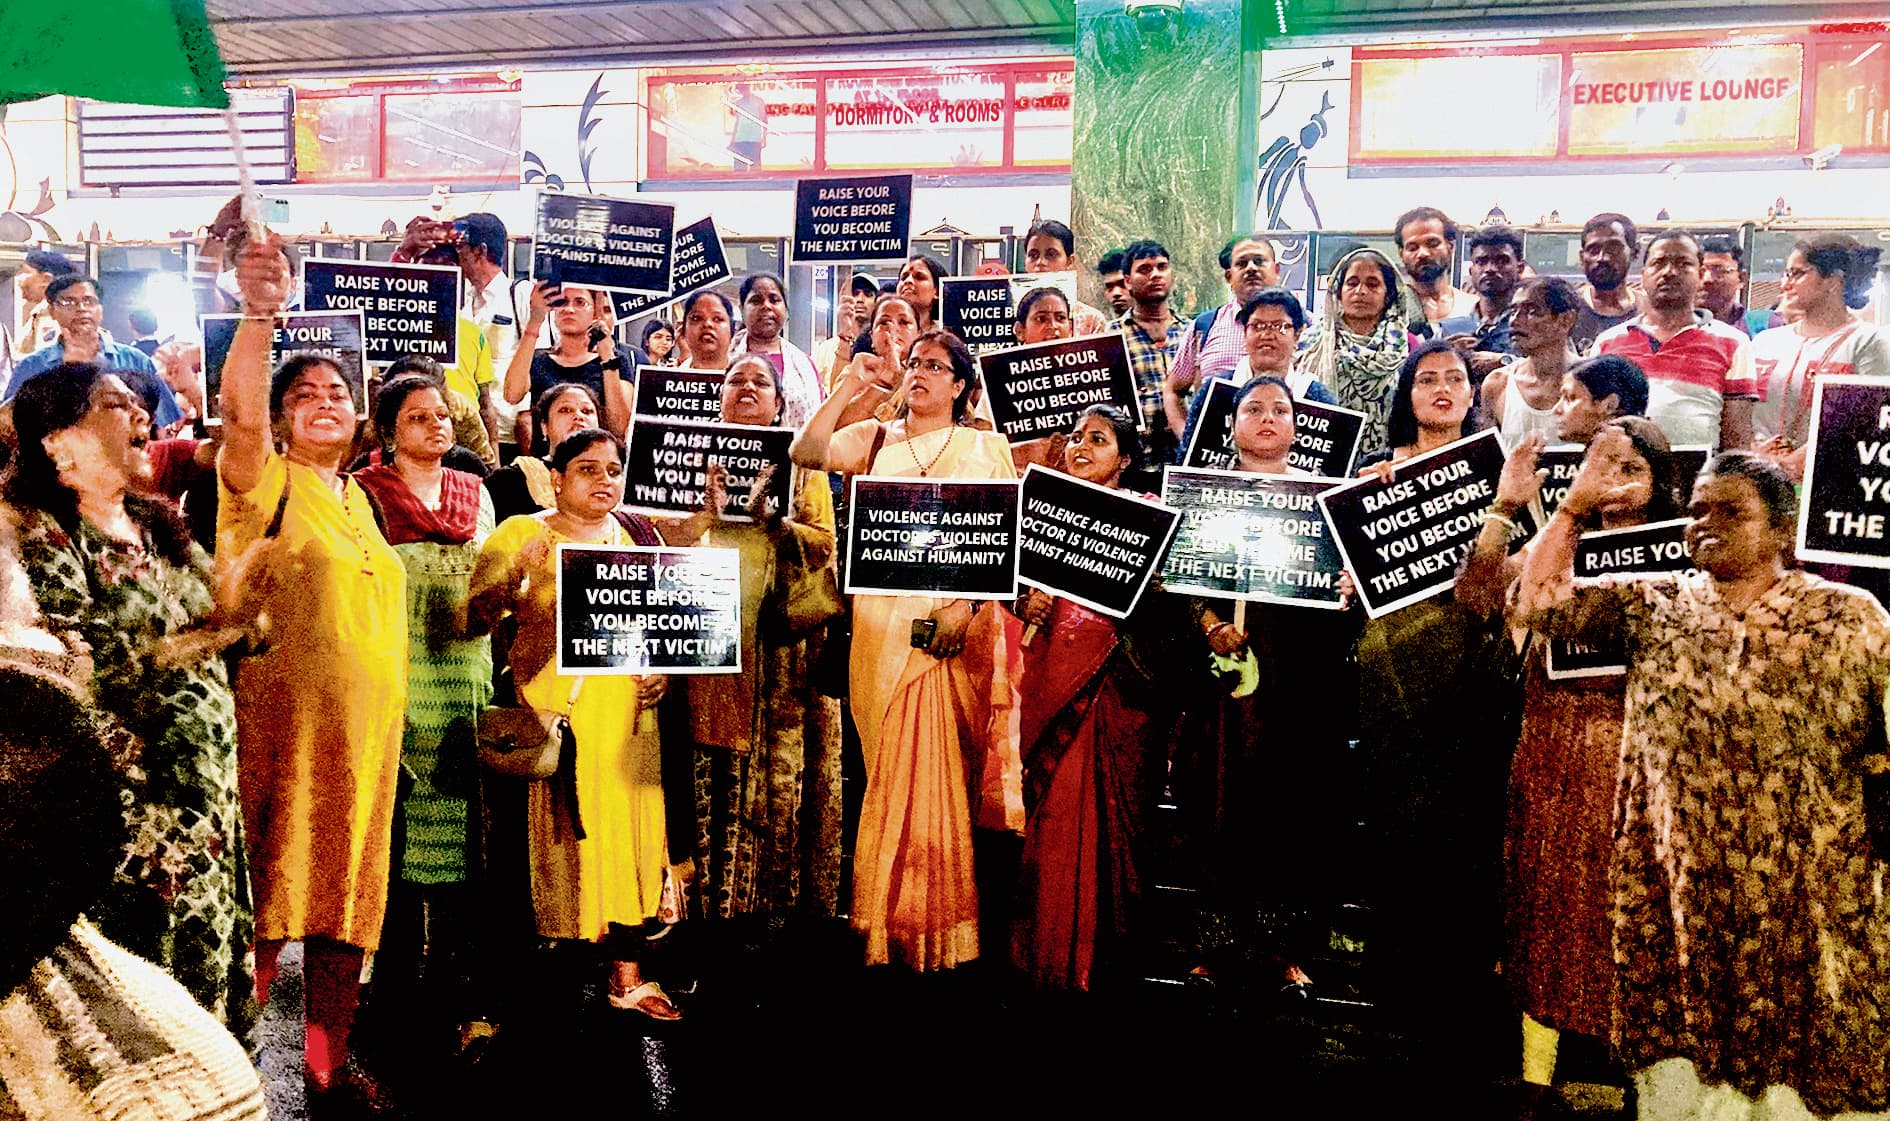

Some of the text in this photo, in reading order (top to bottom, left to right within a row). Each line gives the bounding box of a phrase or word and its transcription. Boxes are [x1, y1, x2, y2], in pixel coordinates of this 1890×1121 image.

[1573, 77, 1790, 105] EXECUTIVE LOUNGE
[929, 105, 940, 123] &
[945, 102, 1000, 122] ROOMS
[819, 186, 890, 200] RAISE YOUR
[811, 203, 896, 218] VOICE BEFORE
[609, 224, 661, 239] AGAINST
[813, 221, 892, 235] YOU BECOME
[608, 239, 666, 254] VIOLENCE
[674, 242, 705, 262] FORE
[800, 238, 901, 252] THE NEXT VICTIM
[598, 253, 663, 269] HUMANITY
[672, 255, 706, 277] COME
[334, 274, 429, 293] RAISE YOUR
[679, 263, 721, 288] VICTIM
[325, 294, 437, 314] VOICE BEFORE
[620, 296, 645, 312] THE
[967, 288, 1006, 302] RAISE
[960, 307, 1001, 319] VOICE
[287, 326, 333, 342] YOUR
[368, 317, 433, 334] BECOME
[963, 325, 992, 337] YOU
[365, 337, 447, 354] EXT VICTIM
[1009, 350, 1098, 375] RAISE YOUR
[665, 380, 706, 394] RAISE
[1005, 367, 1112, 395] VOICE BEFORE
[656, 396, 700, 411] VOICE
[1013, 387, 1112, 414] YOU BECOME
[1003, 420, 1033, 435] THE
[1034, 412, 1074, 430] NEXT
[1296, 413, 1330, 433] OUR
[663, 431, 763, 452] RAISE YOUR
[1293, 433, 1333, 453] FORE
[652, 449, 771, 471] VOICE BEFORE
[654, 467, 691, 485] YOU
[635, 484, 667, 503] THE
[671, 489, 706, 506] NEX
[1362, 460, 1473, 513] RAISE YOUR
[1200, 487, 1314, 511] RAISE YOUR
[868, 509, 1004, 526] VIOLENCE AGAINST
[1361, 479, 1493, 541] VOICE BEFORE
[1027, 498, 1088, 530] VIOLENCE
[1089, 519, 1150, 548] AGAINST
[1825, 509, 1885, 540] THE
[939, 532, 1008, 546] VIOLENCE
[1020, 516, 1147, 568] OCTOR IS VIOLENCE
[1376, 535, 1419, 563] YOU
[1420, 509, 1486, 547] BECOM
[861, 548, 1006, 565] AGAINST HUMANITY
[1019, 534, 1136, 584] GAINST HUMANITY
[1586, 546, 1645, 570] RAISE
[596, 563, 648, 581] RAISE
[1169, 557, 1331, 589] THE NEXT VICTIM
[1370, 567, 1409, 594] THE
[1409, 547, 1459, 579] NEXT
[585, 588, 705, 607] VOICE BEFOR
[590, 613, 711, 631] YOU BECOME
[572, 638, 727, 655] THE NEXT VICTIM
